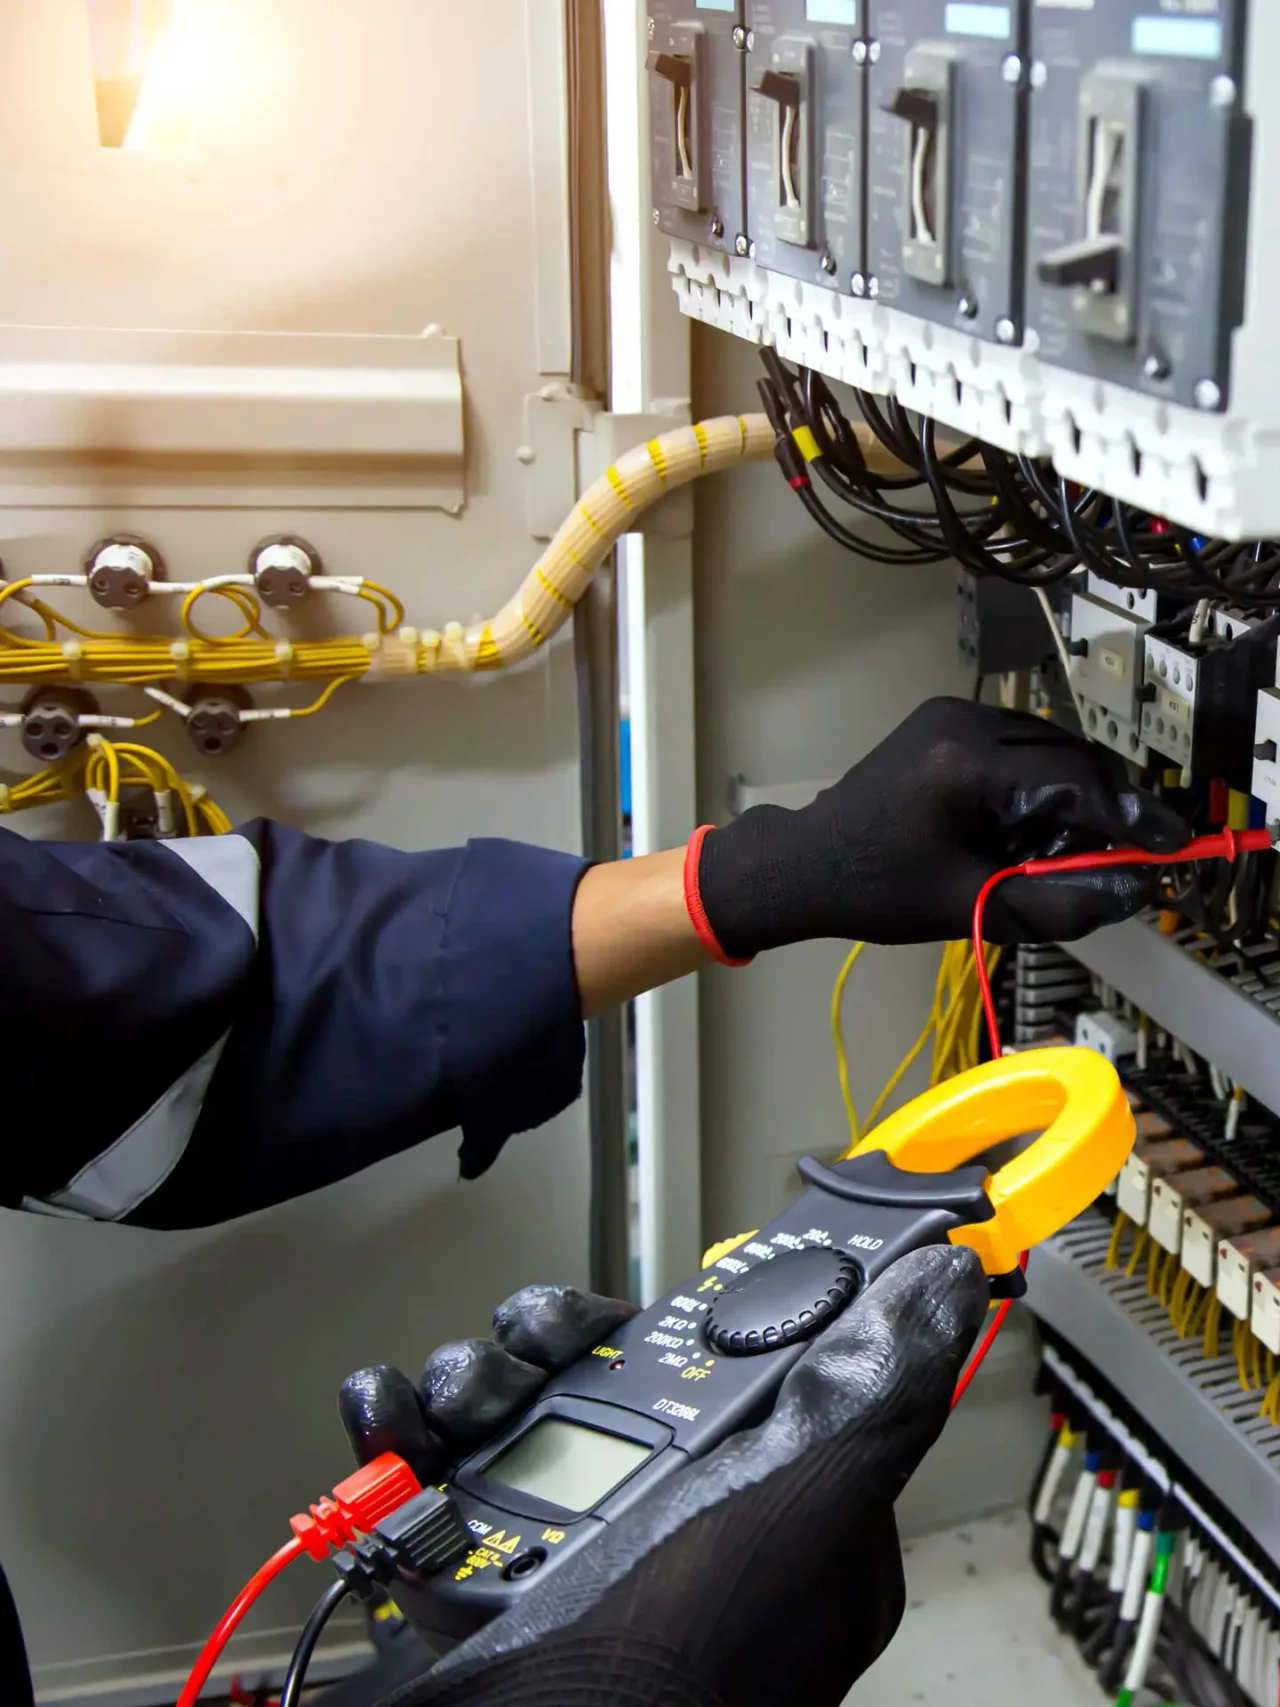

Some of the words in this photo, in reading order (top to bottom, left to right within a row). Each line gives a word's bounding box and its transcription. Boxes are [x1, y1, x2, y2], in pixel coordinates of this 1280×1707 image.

[847, 1234, 884, 1250] HOLD
[591, 1345, 624, 1359] LIGHT
[681, 1366, 711, 1381] OFF
[467, 1519, 493, 1535] COM
